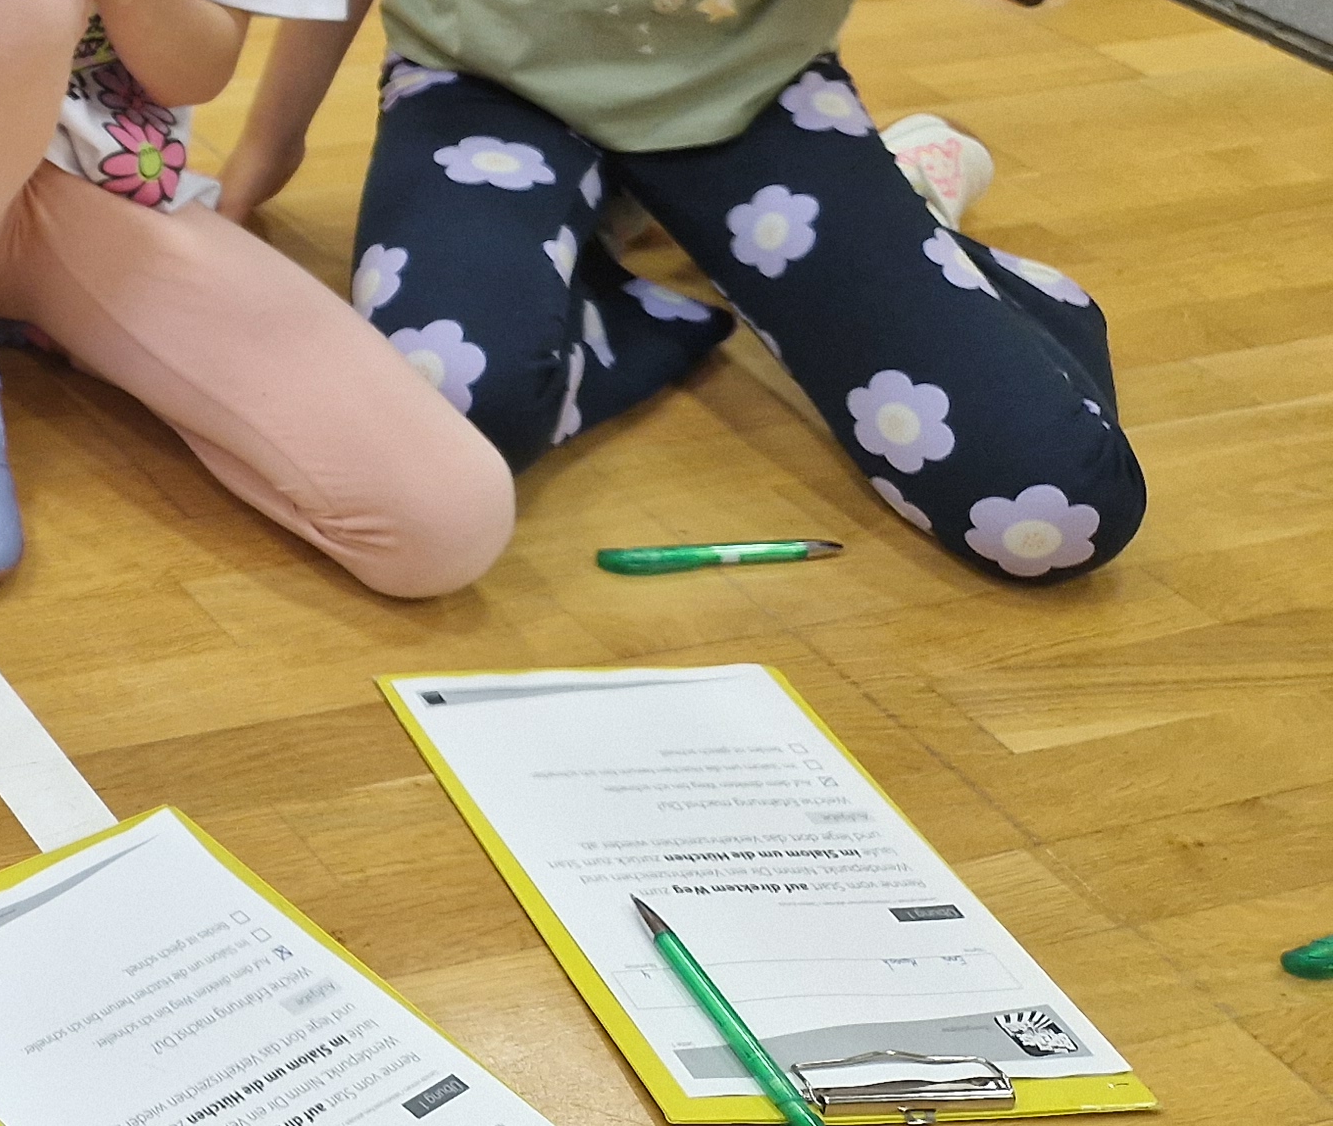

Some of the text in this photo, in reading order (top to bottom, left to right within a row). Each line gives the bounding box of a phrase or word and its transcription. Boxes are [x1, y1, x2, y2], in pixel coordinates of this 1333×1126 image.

[663, 851, 730, 862] Hütchen
[731, 851, 755, 861] die
[758, 850, 783, 859] um
[785, 849, 839, 859] Slalom
[838, 849, 861, 859] im
[546, 859, 581, 869] Start
[582, 857, 611, 867] zum
[579, 876, 609, 885] und
[810, 882, 846, 892] Start
[846, 881, 880, 890] vom
[638, 887, 669, 897] zum
[672, 885, 711, 895] Weg
[711, 883, 781, 895] direktem
[784, 883, 808, 894] auf
[187, 960, 204, 972] um
[253, 956, 271, 971] Auf
[230, 964, 254, 979] dem
[192, 975, 231, 998] direkten
[99, 996, 135, 1017] herum
[168, 995, 197, 1010] Weg
[82, 1012, 102, 1025] bin
[150, 966, 313, 1056] Welche Erfahrung machst Du?
[153, 1006, 174, 1019] bin
[331, 1003, 355, 1022] und
[66, 1020, 84, 1033] ich
[137, 1014, 154, 1026] ich
[306, 1017, 335, 1033] lege
[346, 1018, 379, 1039] laufe
[279, 1029, 307, 1047] dort
[328, 1034, 351, 1048] im
[258, 1042, 281, 1057] das
[285, 1044, 333, 1071] Slalom
[320, 1035, 400, 1080] Wendepunkt.
[379, 1051, 421, 1078] Renne
[166, 1053, 263, 1107] Verkehrszeichen
[263, 1067, 287, 1083] um
[352, 1073, 382, 1092] vom
[241, 1079, 264, 1095] die
[284, 1076, 326, 1100] Nimm
[423, 1080, 464, 1104] Übung
[267, 1096, 289, 1111] Dir
[325, 1087, 357, 1108] Start
[186, 1091, 246, 1124] Hütchen
[303, 1103, 327, 1123] auf
[418, 1100, 430, 1111] 1
[245, 1106, 268, 1122] ein
